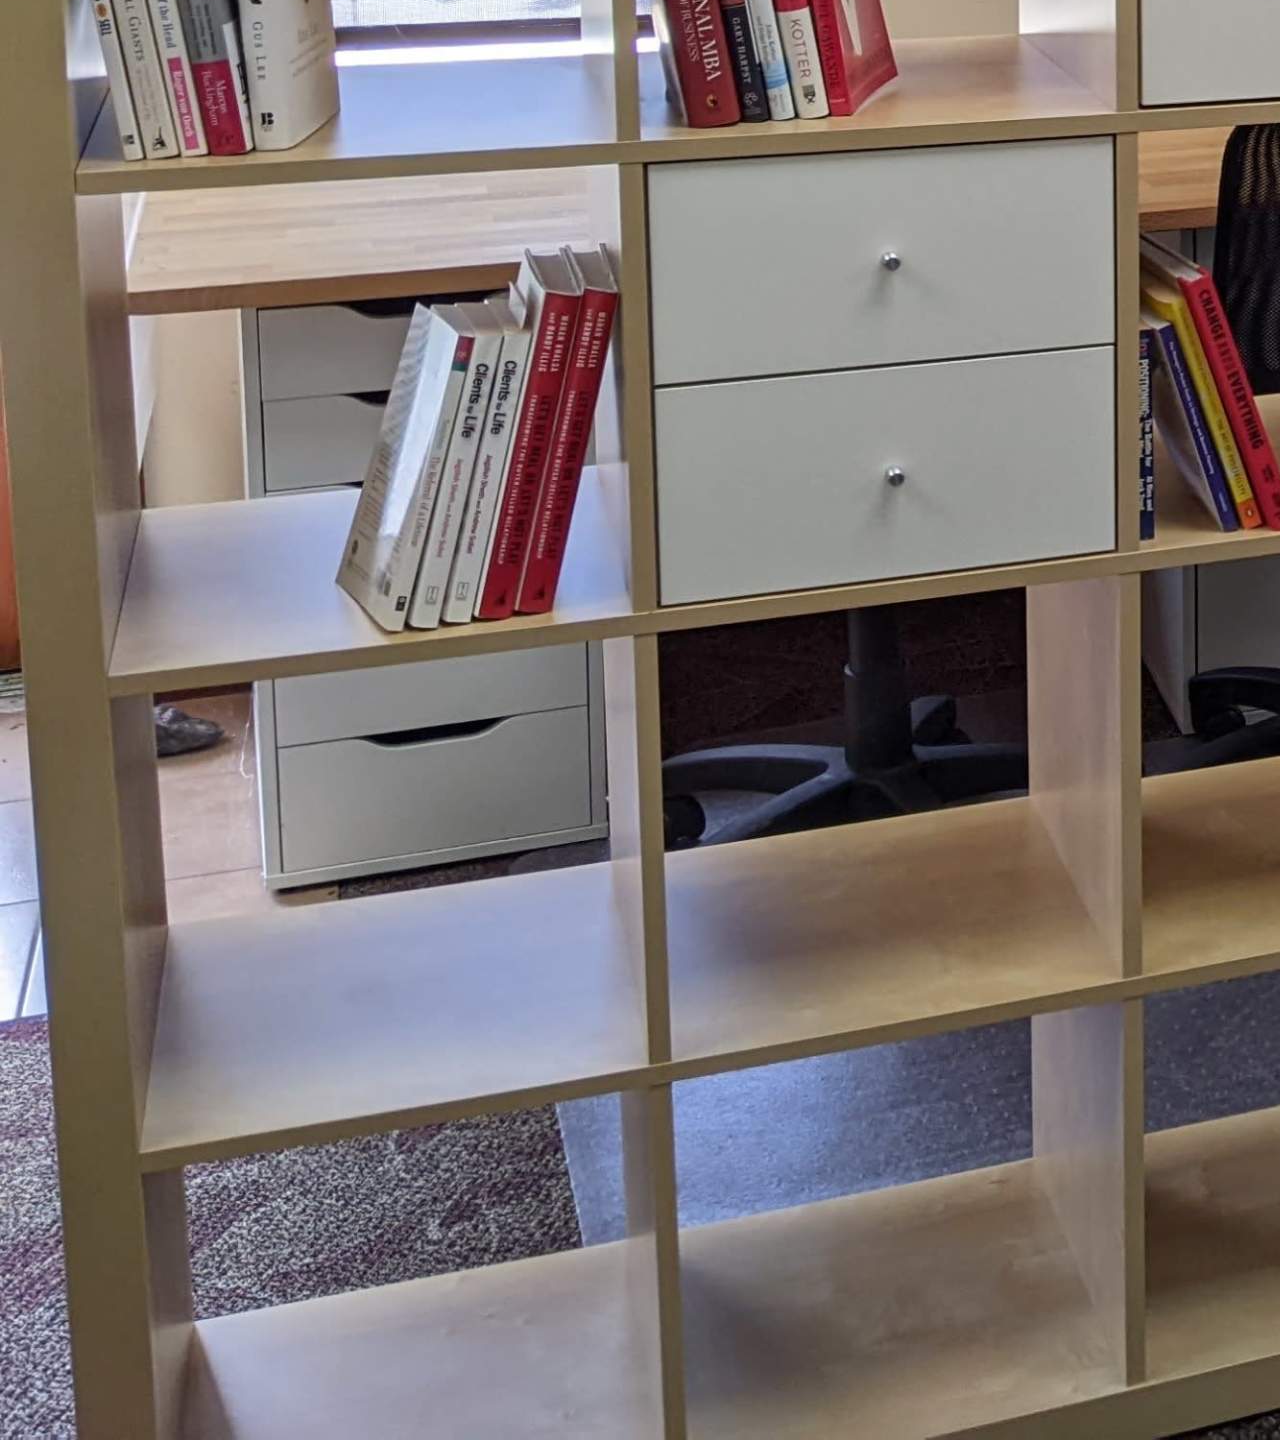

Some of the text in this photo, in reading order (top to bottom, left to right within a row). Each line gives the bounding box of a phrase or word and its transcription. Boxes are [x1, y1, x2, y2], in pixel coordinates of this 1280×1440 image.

[99, 19, 112, 35] SELL
[159, 5, 171, 22] the
[733, 17, 744, 43] GARY
[128, 17, 148, 61] GIANTS
[163, 24, 176, 48] Head
[681, 11, 699, 62] BUSINESS
[790, 19, 811, 78] KOTTER
[700, 42, 723, 82] MBA
[172, 71, 186, 97] Roger
[214, 80, 231, 112] Marcus
[1199, 288, 1225, 341] CHANGE
[469, 363, 489, 405] Clients
[497, 360, 517, 401] Clients
[461, 415, 477, 439] Life
[490, 412, 506, 436] Life
[1227, 371, 1263, 449] EVERYTHING
